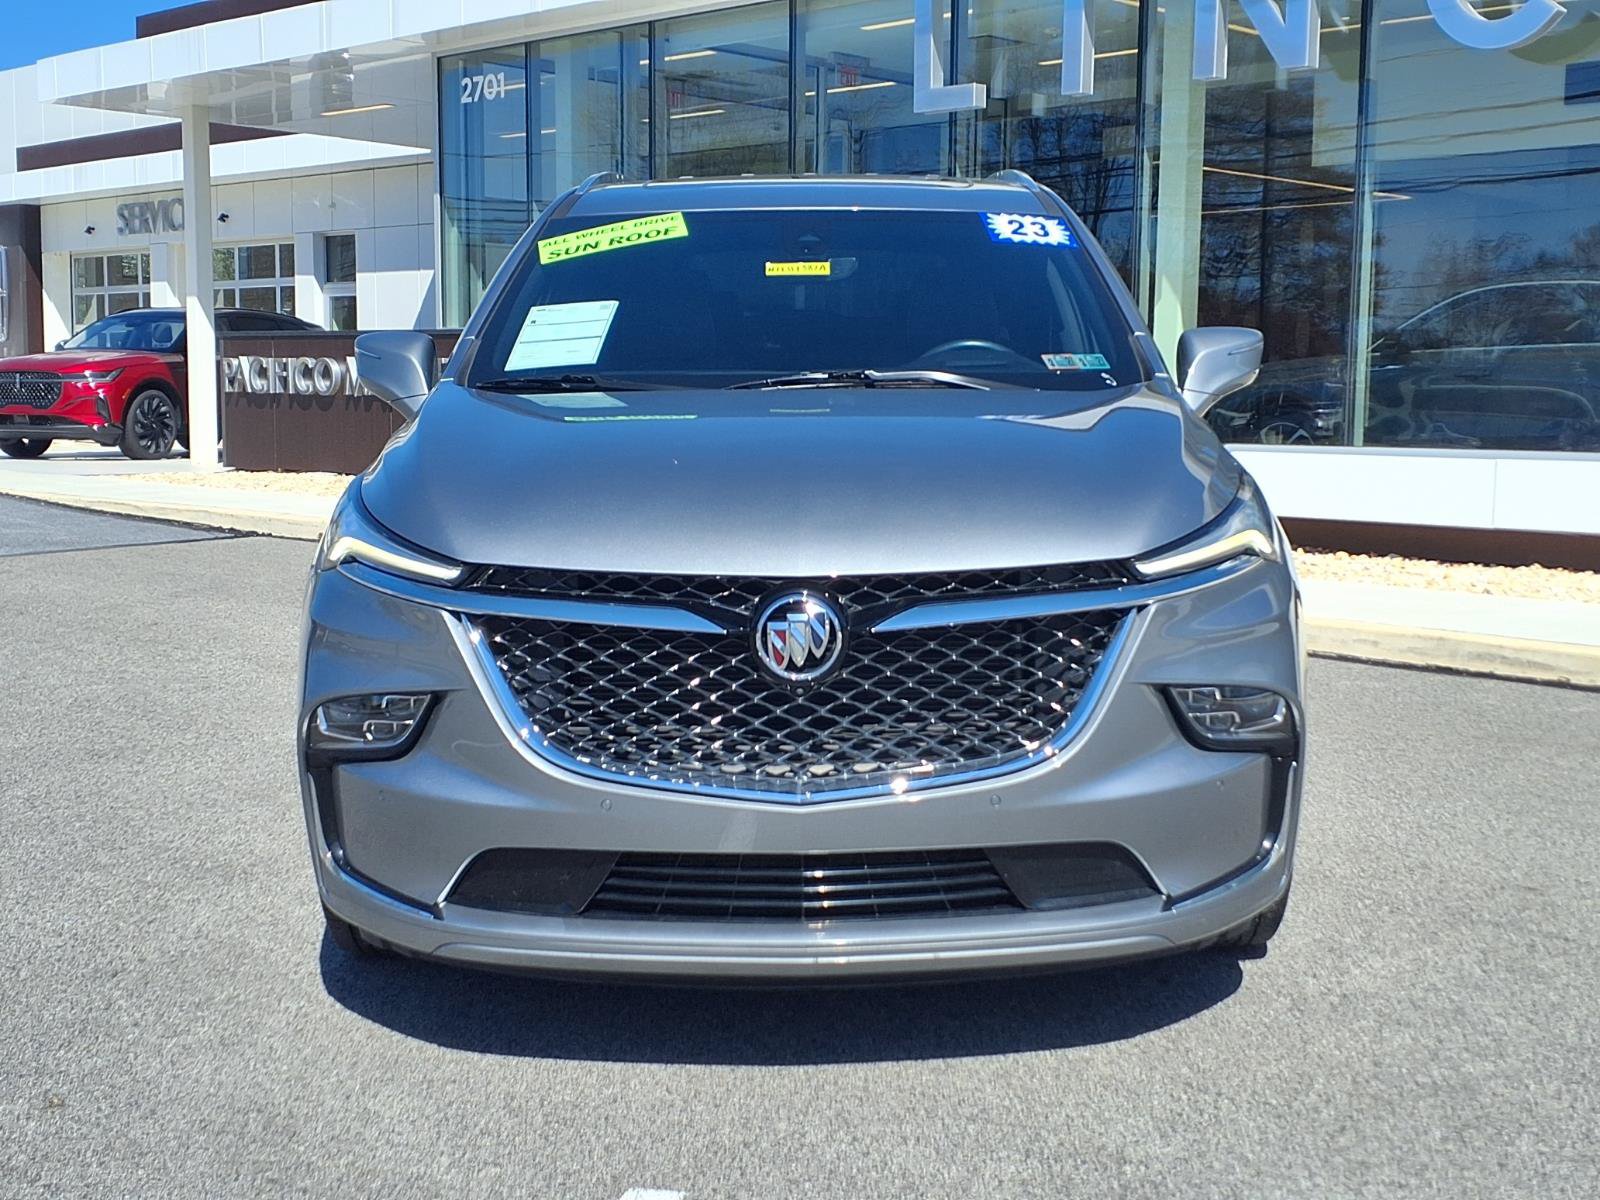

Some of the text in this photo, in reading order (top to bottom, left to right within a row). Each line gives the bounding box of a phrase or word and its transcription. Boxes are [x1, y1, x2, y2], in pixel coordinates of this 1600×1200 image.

[461, 72, 504, 104] 2701
[543, 214, 679, 248] ALL WHEEL DRIVE
[547, 226, 678, 260] SUN ROOF
[1007, 219, 1050, 237] 23
[224, 356, 341, 395] PACIFICO
